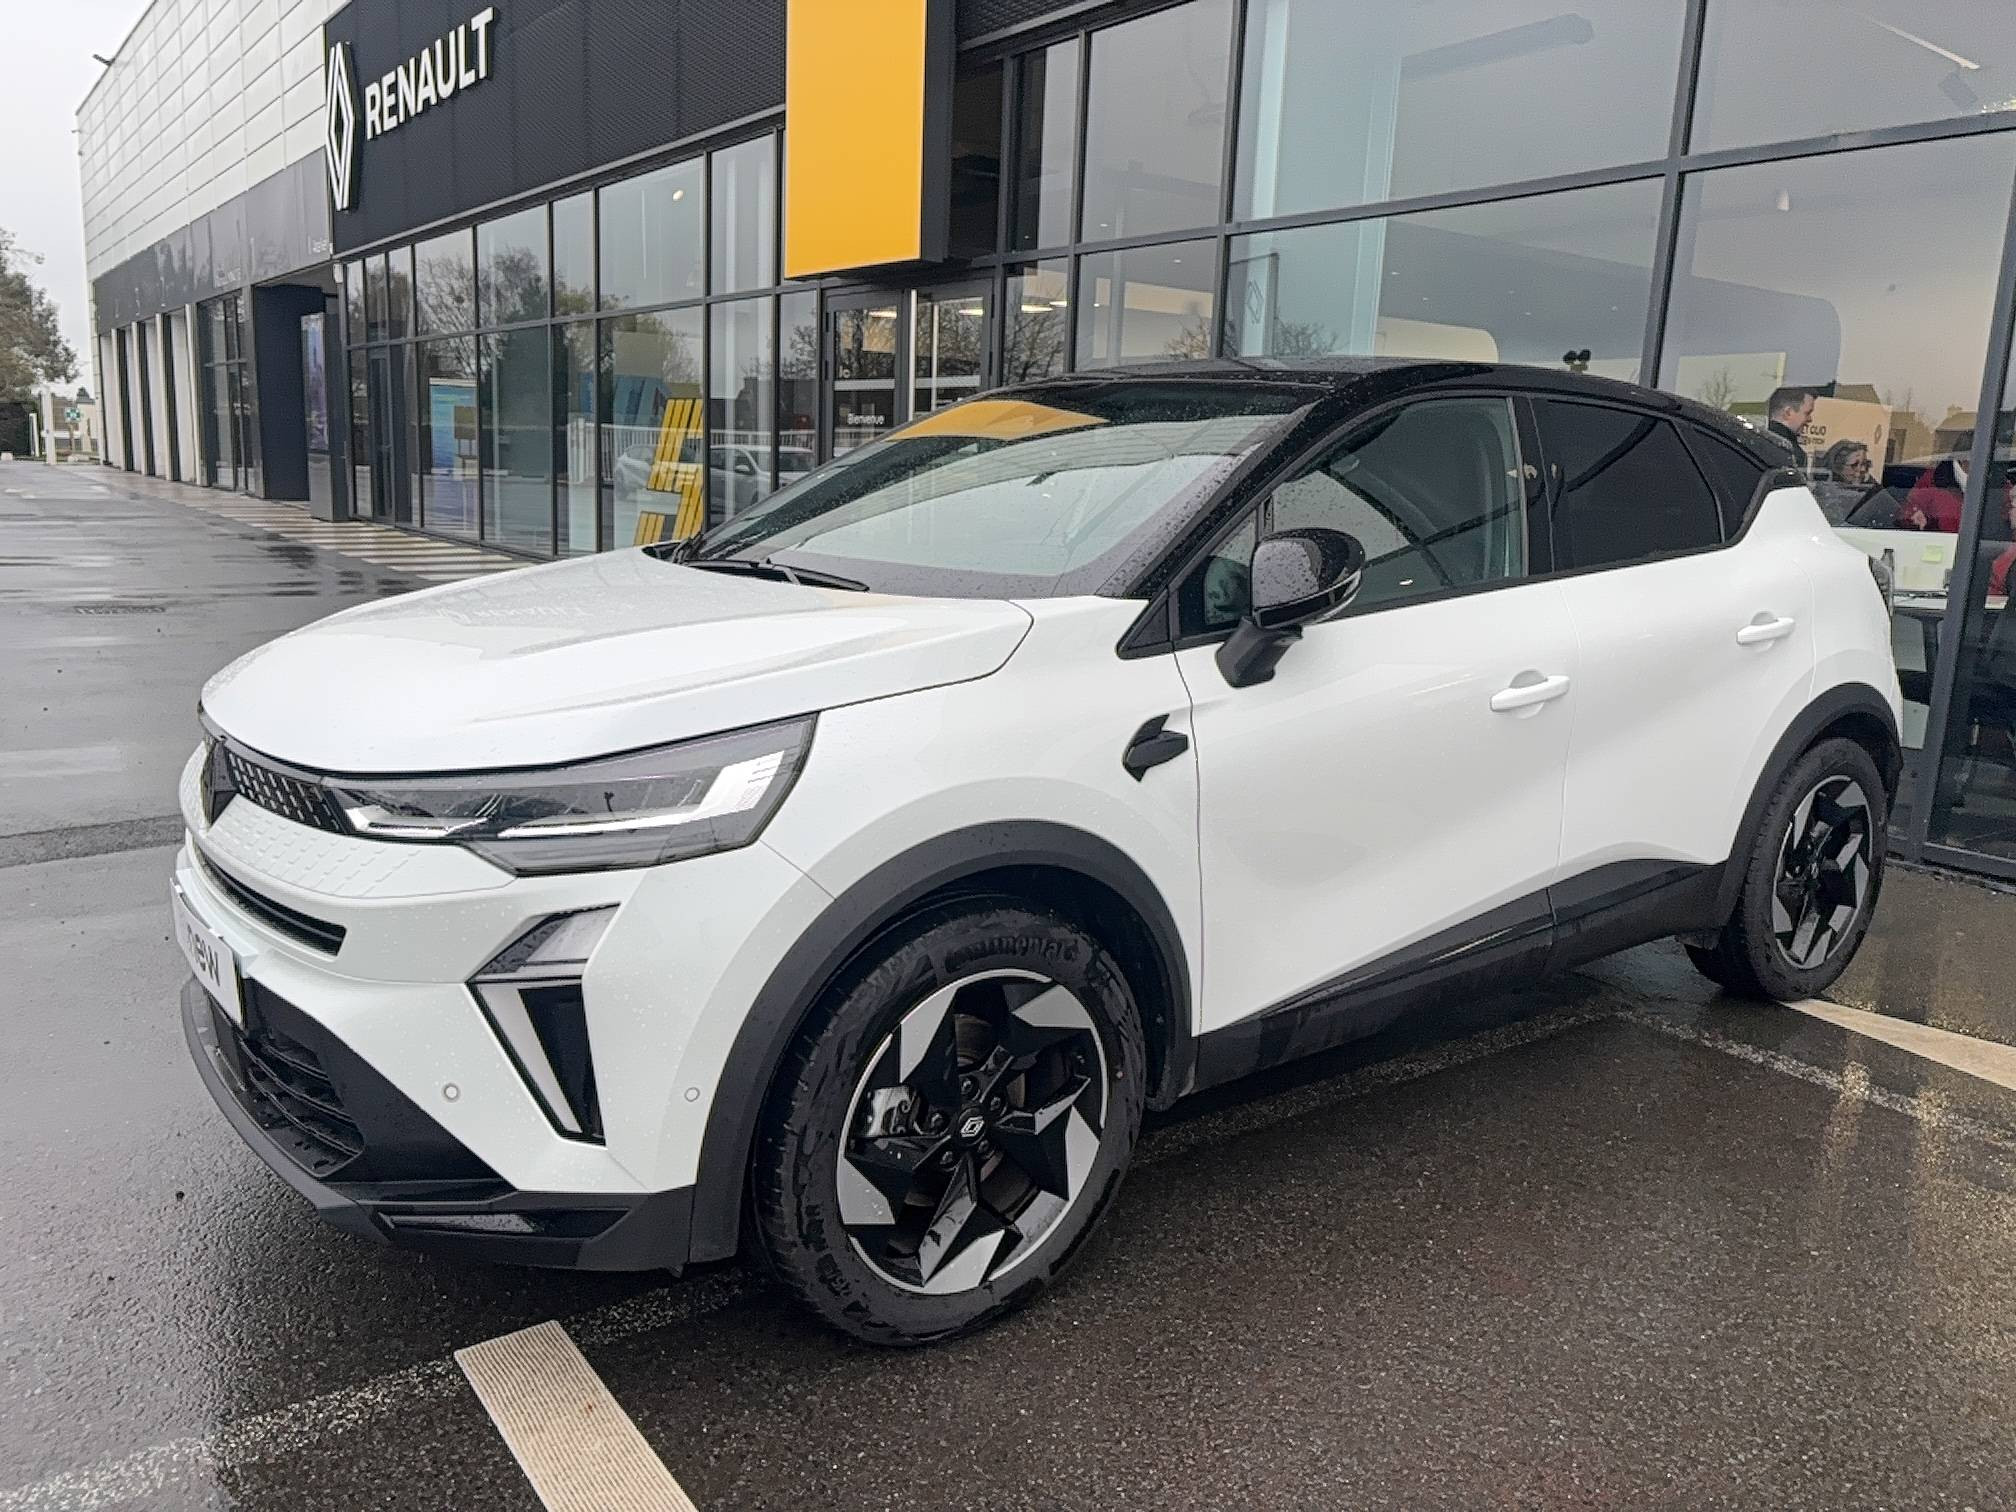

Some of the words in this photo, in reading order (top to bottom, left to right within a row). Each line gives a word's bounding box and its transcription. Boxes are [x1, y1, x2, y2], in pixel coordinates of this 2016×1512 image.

[365, 7, 493, 140] RENAULT
[847, 412, 885, 425] Bienvenue
[945, 936, 1063, 973] inental
